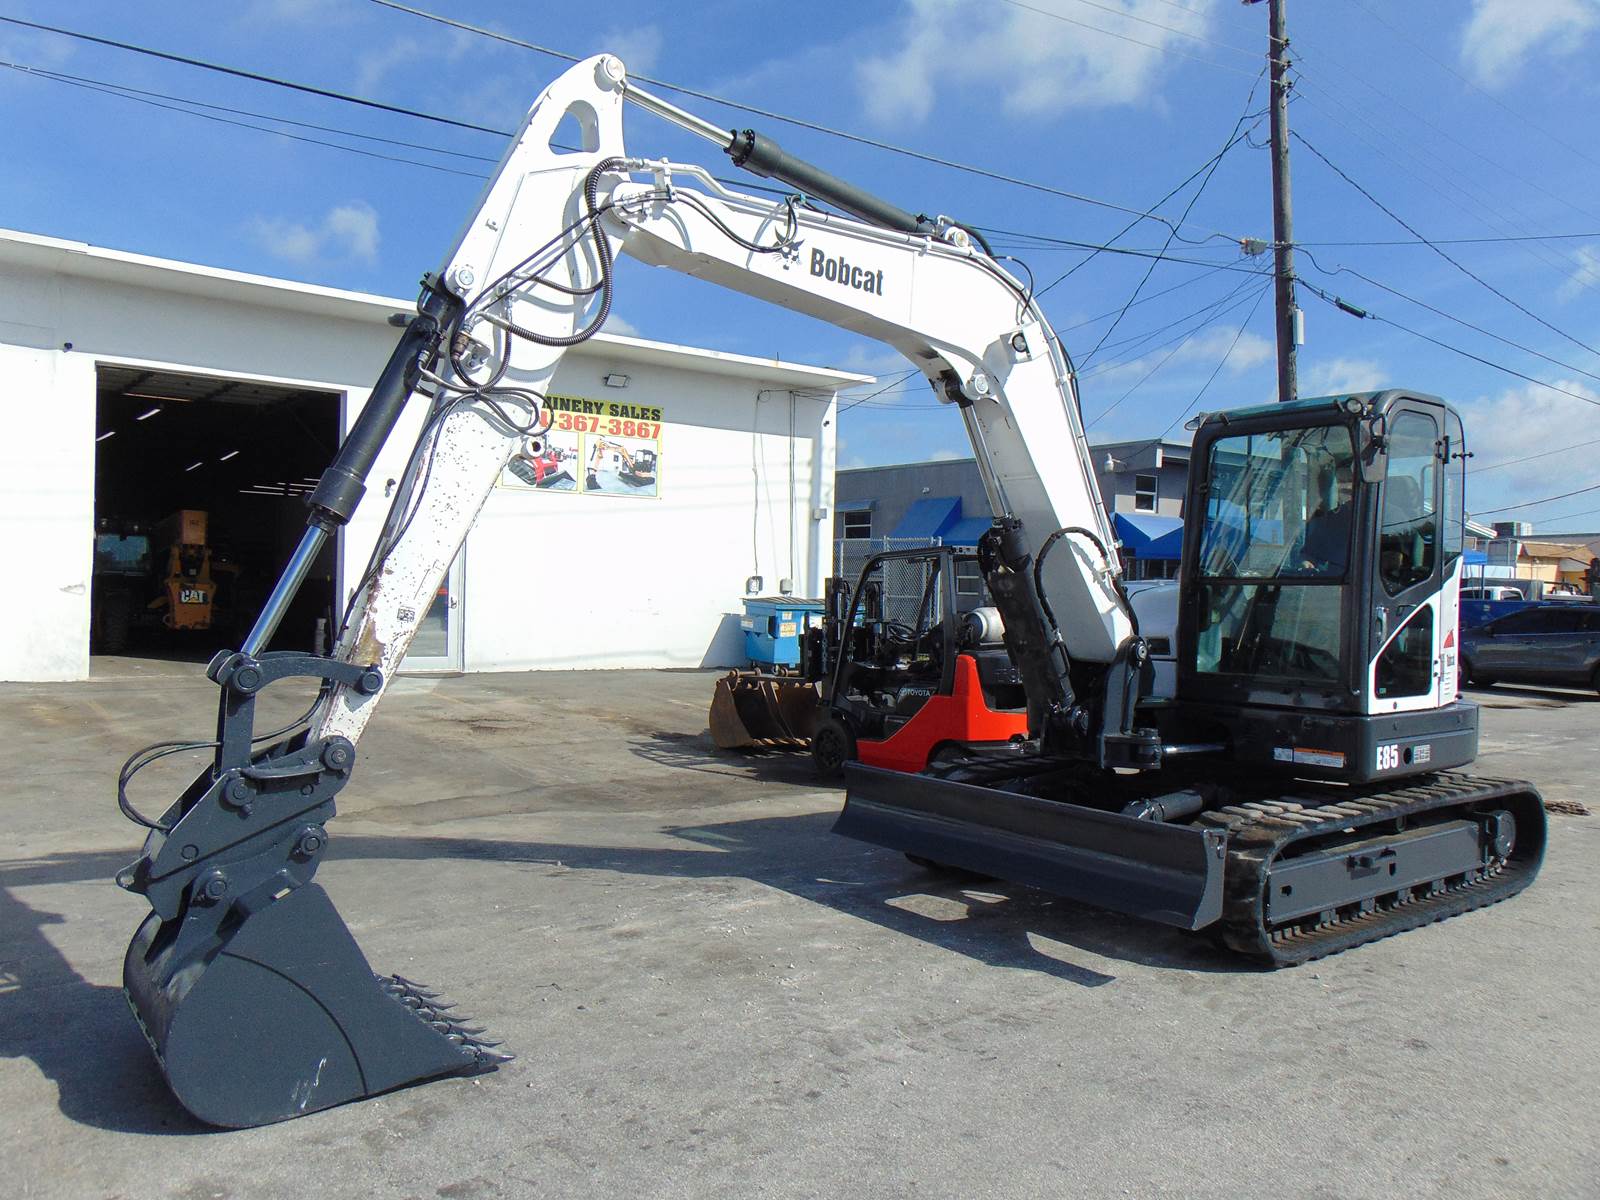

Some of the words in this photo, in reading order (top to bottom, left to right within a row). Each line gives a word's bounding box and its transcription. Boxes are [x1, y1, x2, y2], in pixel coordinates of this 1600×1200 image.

[810, 247, 883, 296] Bobcat
[609, 403, 661, 421] SALES
[181, 589, 205, 603] CAT
[907, 688, 931, 697] TOYOTA
[1376, 744, 1399, 771] E85
